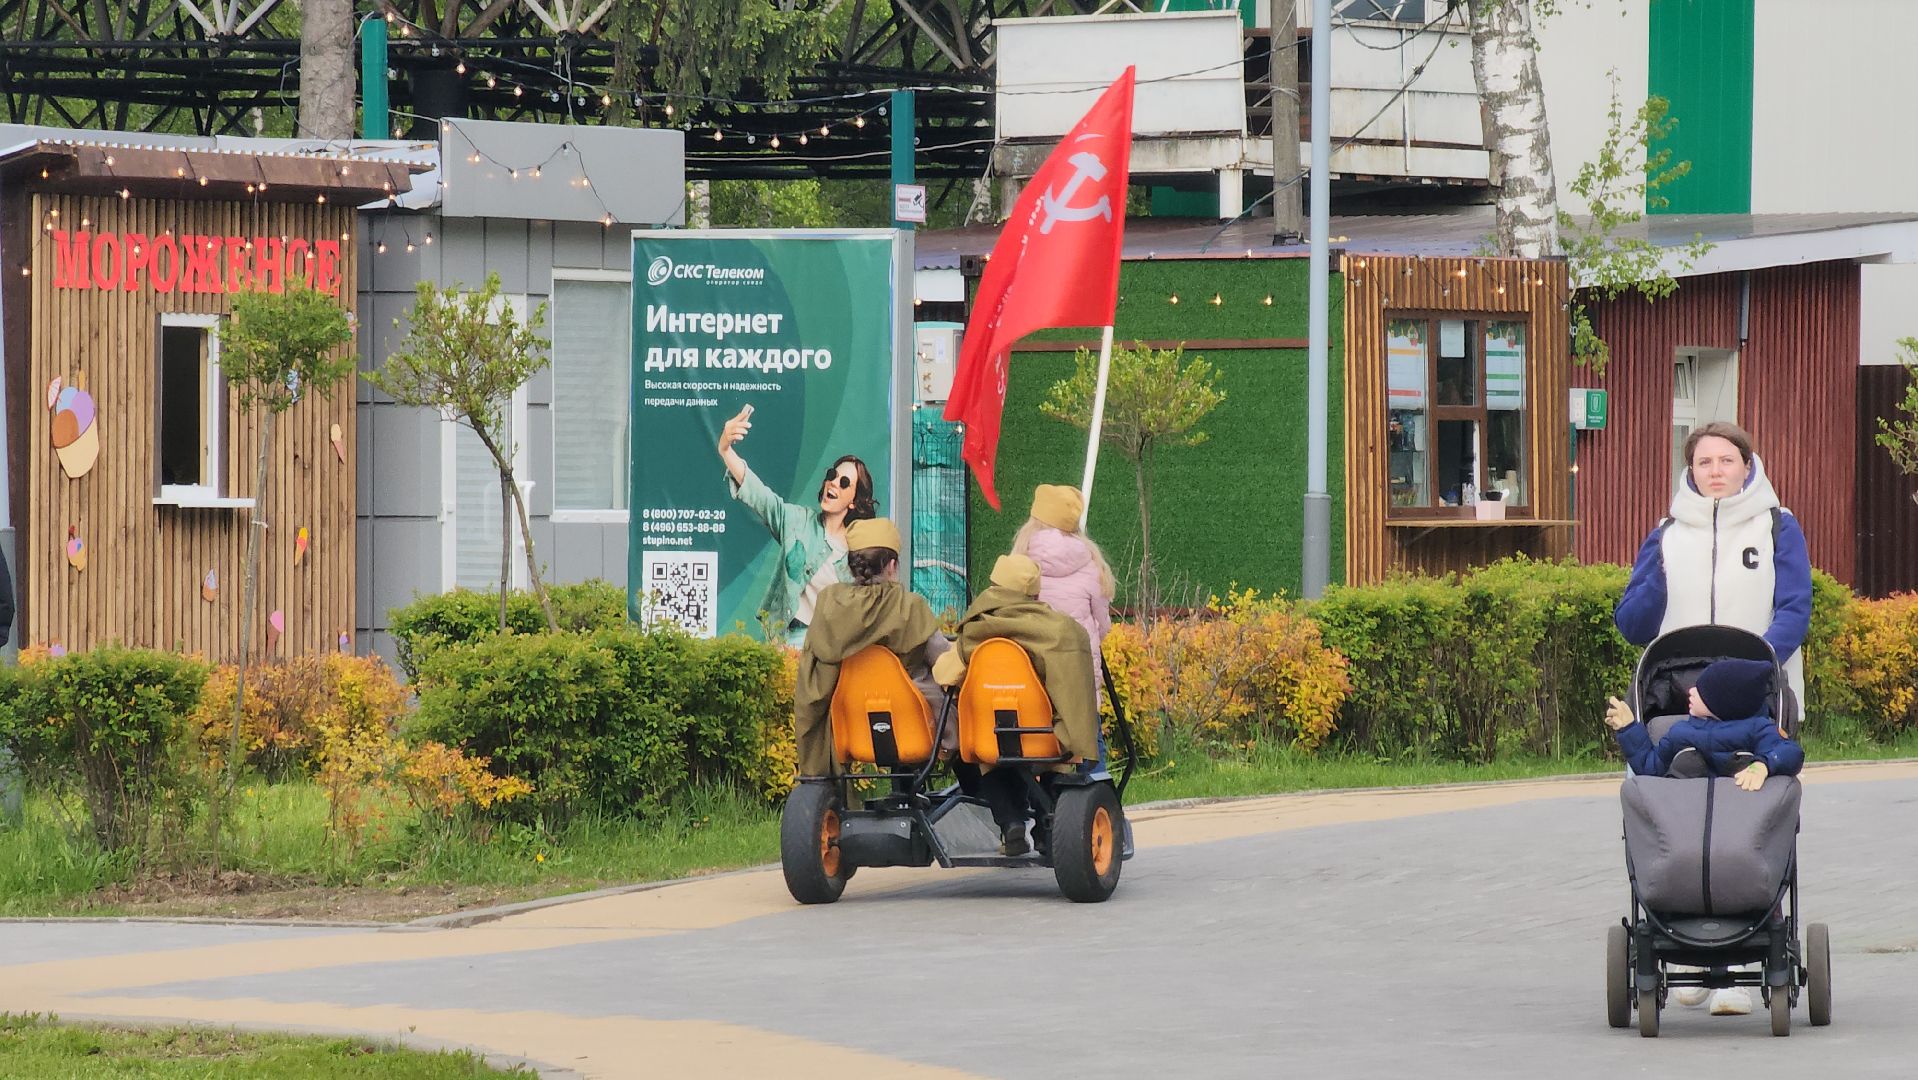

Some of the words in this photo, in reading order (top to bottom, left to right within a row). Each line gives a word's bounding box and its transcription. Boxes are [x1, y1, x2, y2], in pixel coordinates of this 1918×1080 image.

[53, 230, 341, 297] МОРОЖЕНОЕ
[673, 264, 704, 279] СКС
[705, 265, 764, 279] Телеком
[646, 304, 783, 340] Интернет
[644, 347, 699, 373] для
[705, 348, 832, 374] каждого
[644, 379, 682, 390] Высокая
[682, 382, 722, 392] скорость
[723, 382, 729, 390] и
[729, 382, 782, 391] надежность
[644, 397, 685, 407] передачи
[685, 398, 718, 407] данных
[642, 508, 650, 519] 8
[650, 508, 677, 520] (800)
[677, 509, 726, 520] 707-02-20
[642, 521, 650, 532] 8
[650, 521, 676, 533] (496)
[676, 522, 726, 533] 653-88-88
[642, 535, 693, 547] stupino.net
[1742, 546, 1760, 570] C
